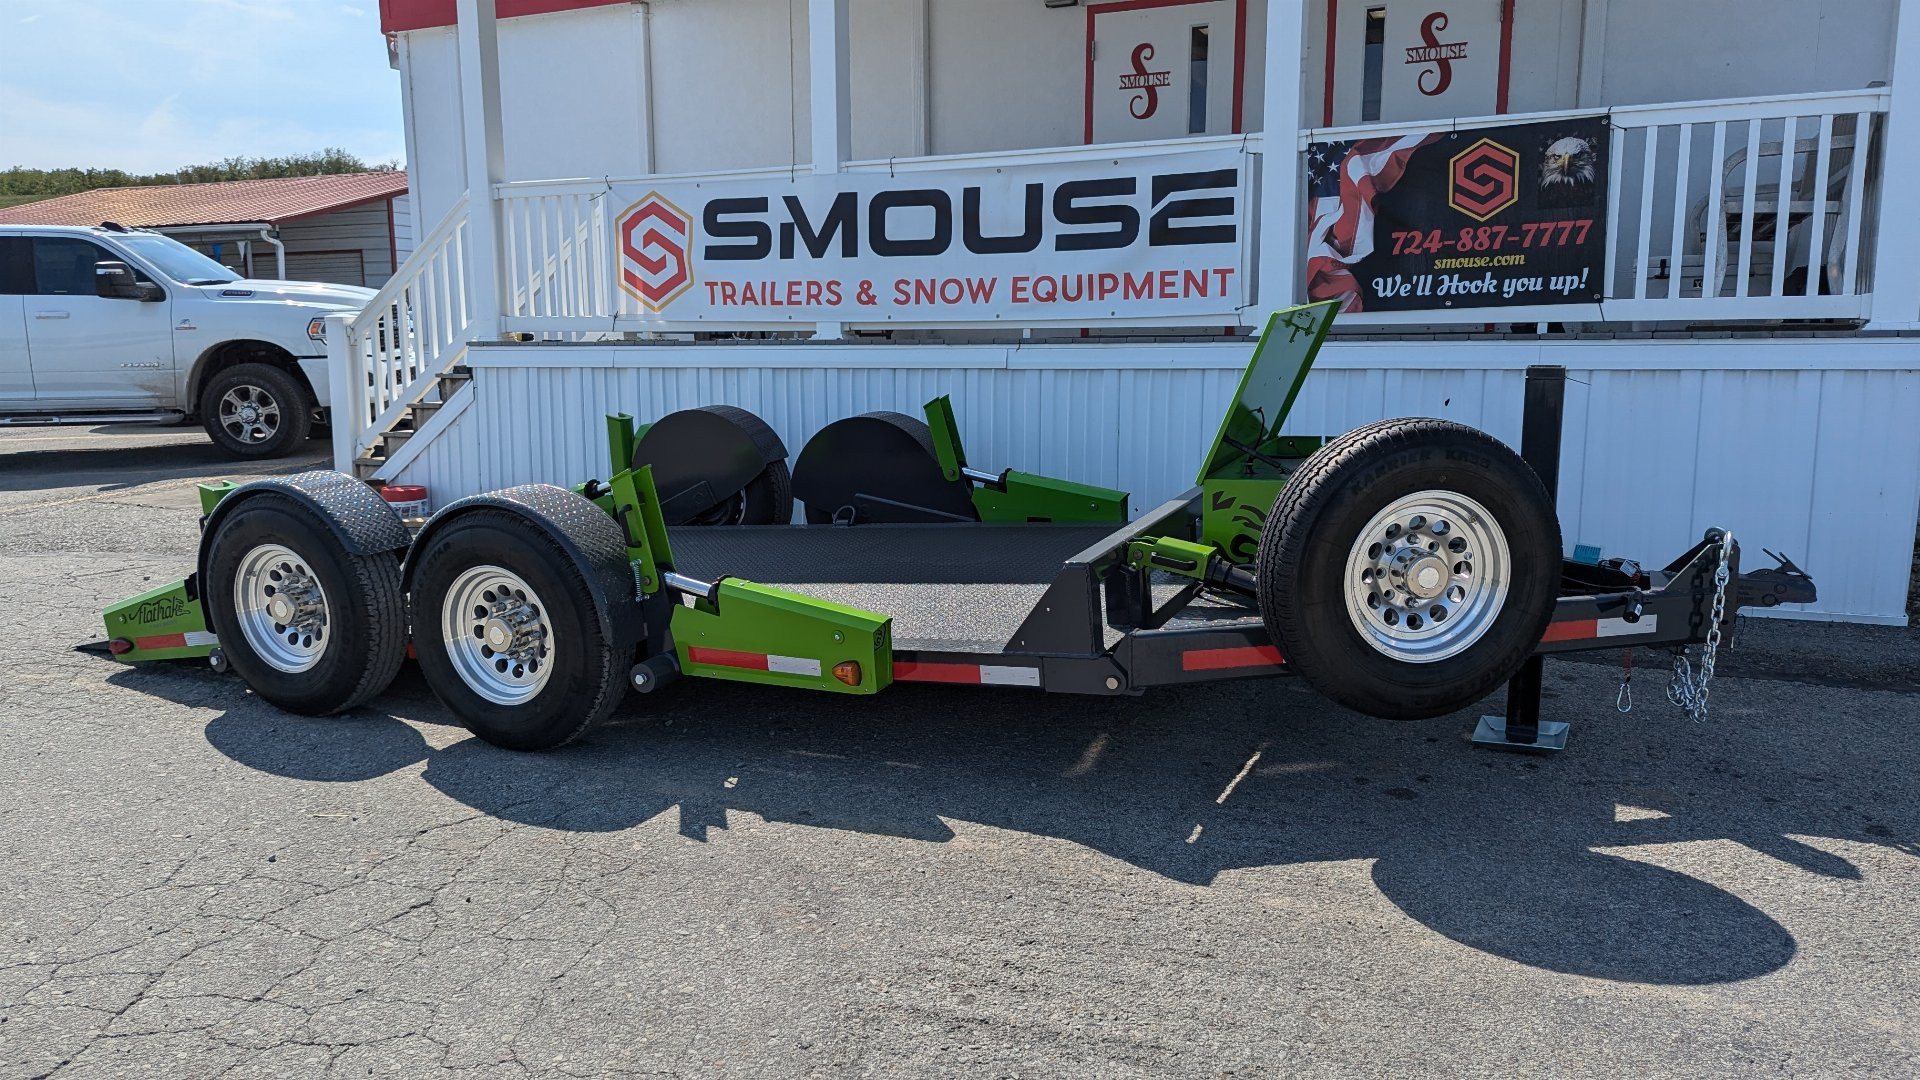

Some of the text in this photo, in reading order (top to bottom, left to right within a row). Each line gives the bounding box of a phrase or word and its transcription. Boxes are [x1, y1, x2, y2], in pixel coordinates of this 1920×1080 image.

[1405, 43, 1468, 63] SMOUSE
[1119, 72, 1170, 89] SMOUSE
[703, 169, 1238, 260] SMOUSE
[1391, 220, 1593, 255] 724-887-7777
[1434, 254, 1525, 270] smouse.com
[705, 268, 1236, 306] TRAILERS & SNOW EQUIPMENT
[1372, 267, 1589, 298] We'll Hook you up!
